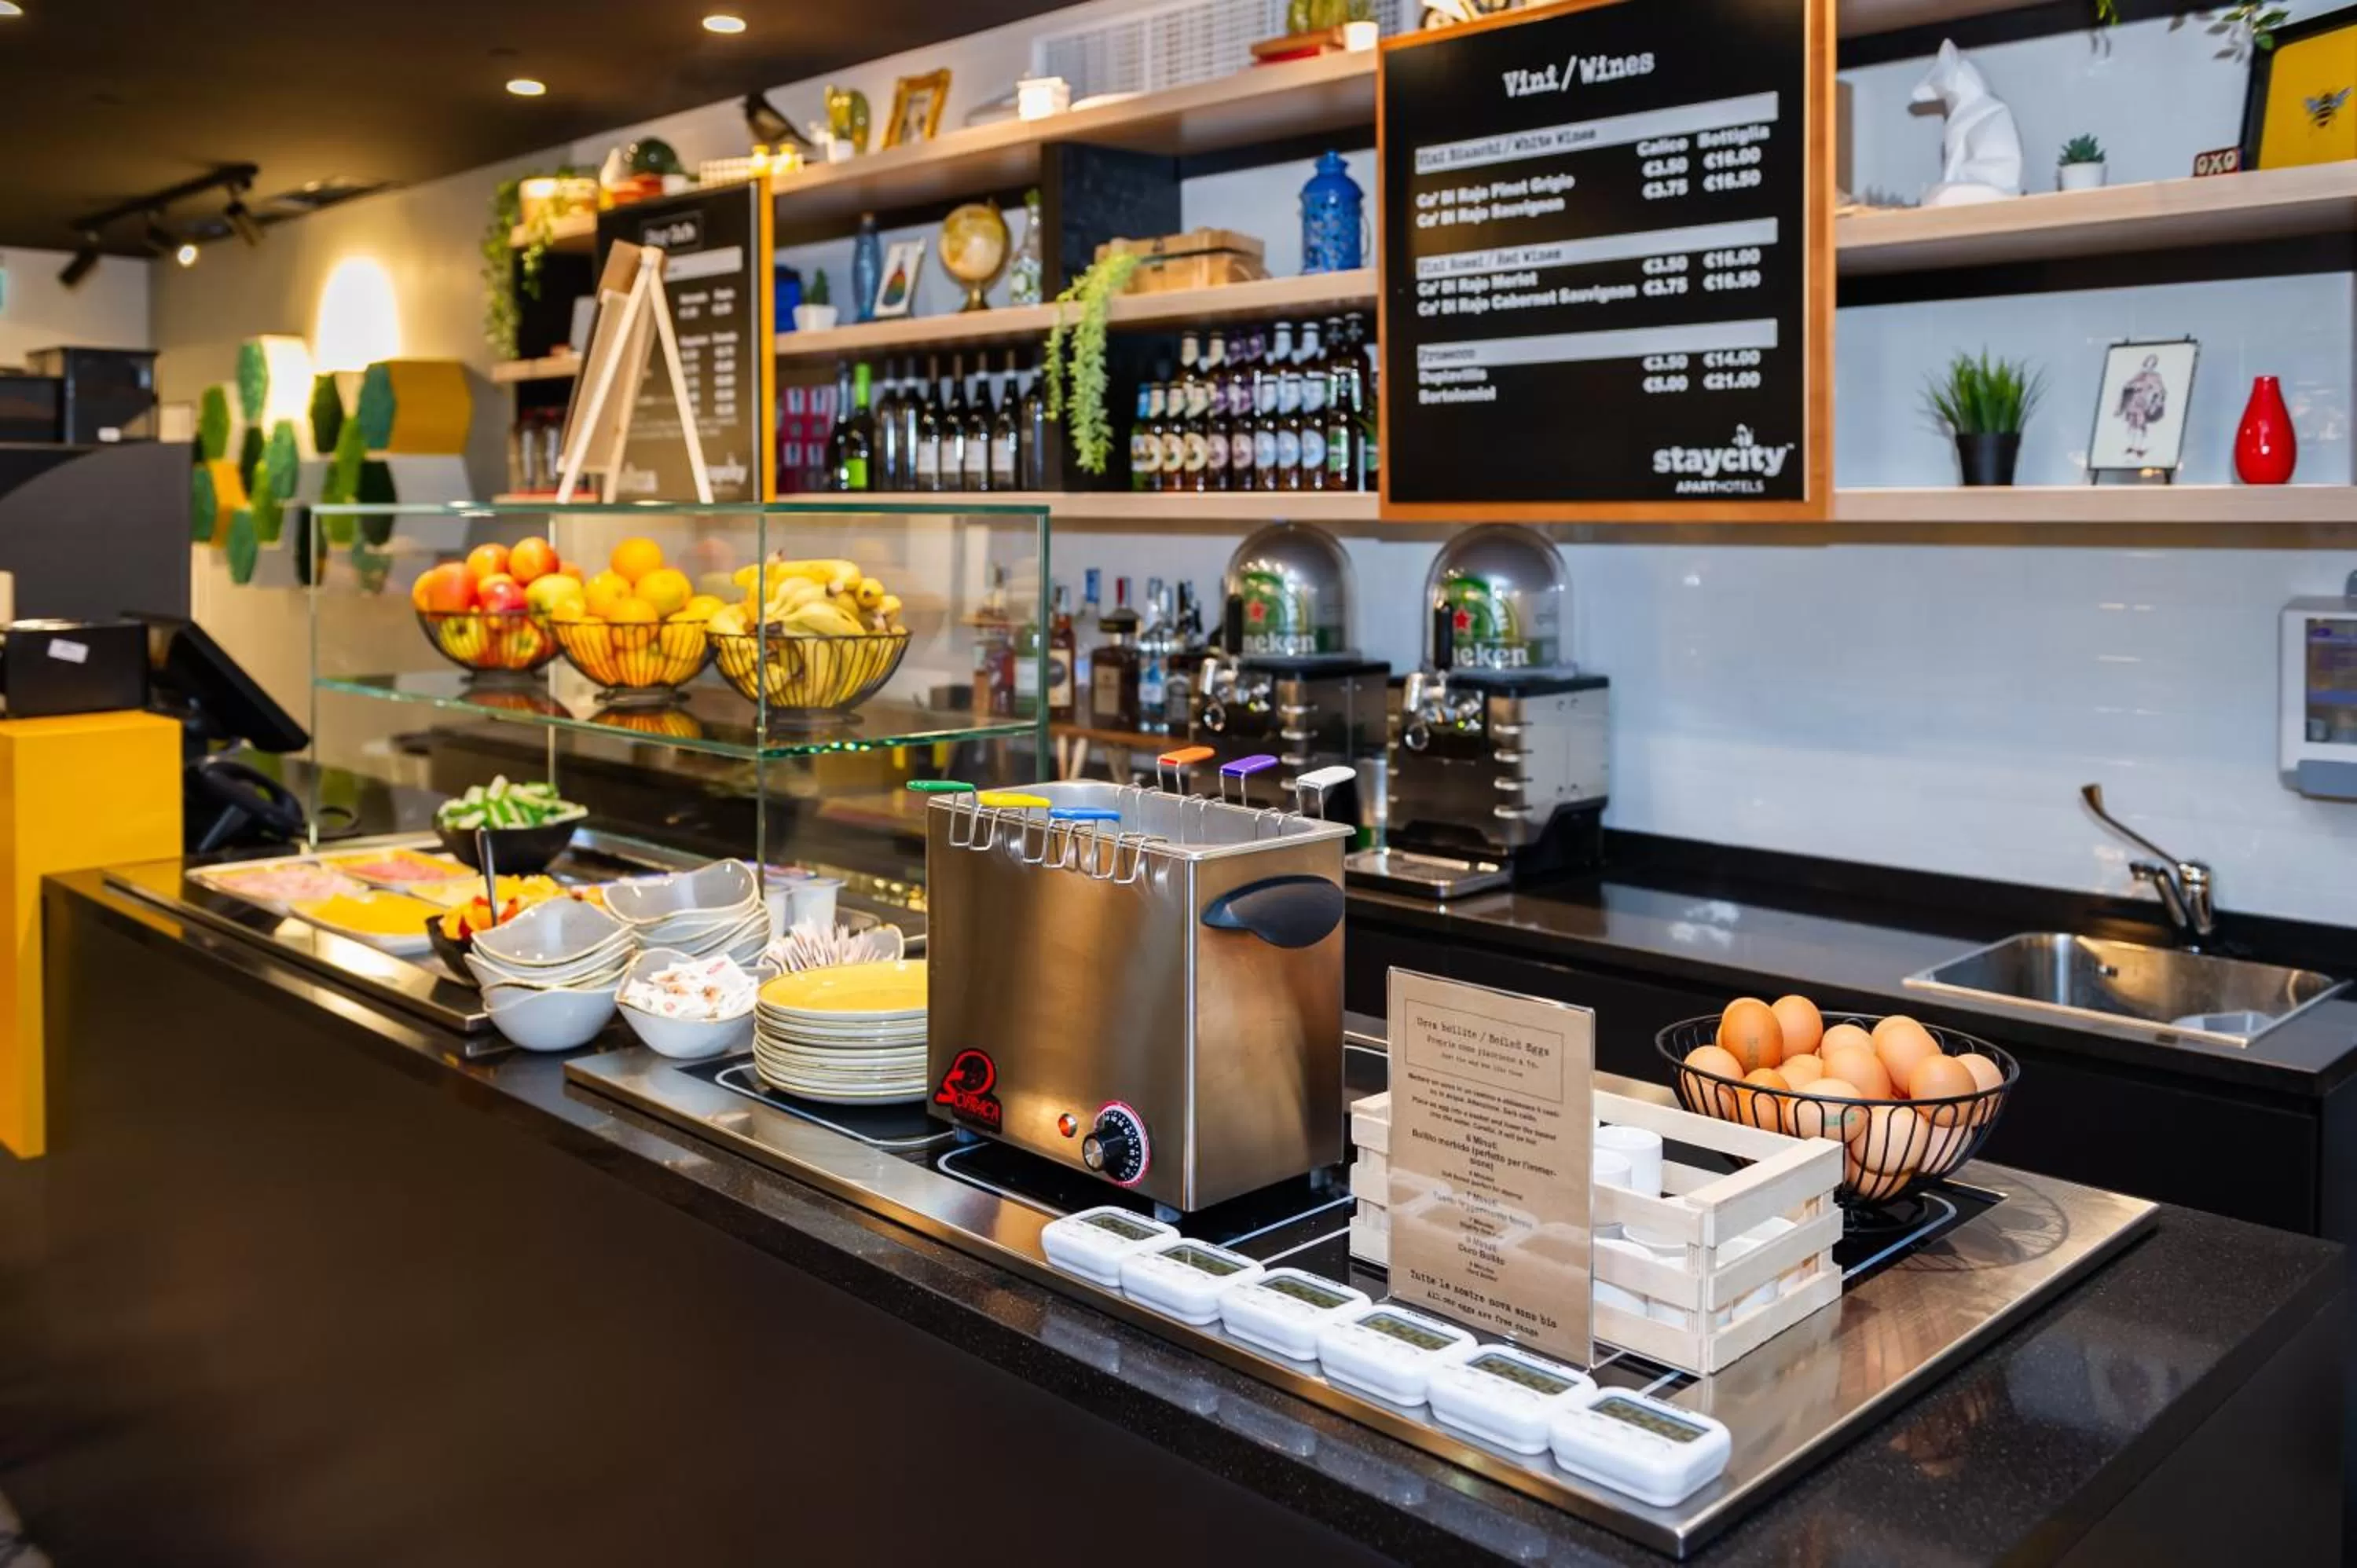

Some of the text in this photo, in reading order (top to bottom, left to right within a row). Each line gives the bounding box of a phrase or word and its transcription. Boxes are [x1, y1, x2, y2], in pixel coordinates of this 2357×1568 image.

[2197, 149, 2238, 175] OXO
[1491, 288, 1556, 310] Cabernet
[1558, 284, 1637, 304] Sauvignon
[1703, 370, 1761, 390] €21.00
[1652, 445, 1787, 478] staycity
[1675, 479, 1765, 494] APARTHOTELS
[1410, 1269, 1436, 1285] Tutte
[1453, 1285, 1486, 1303] nostre
